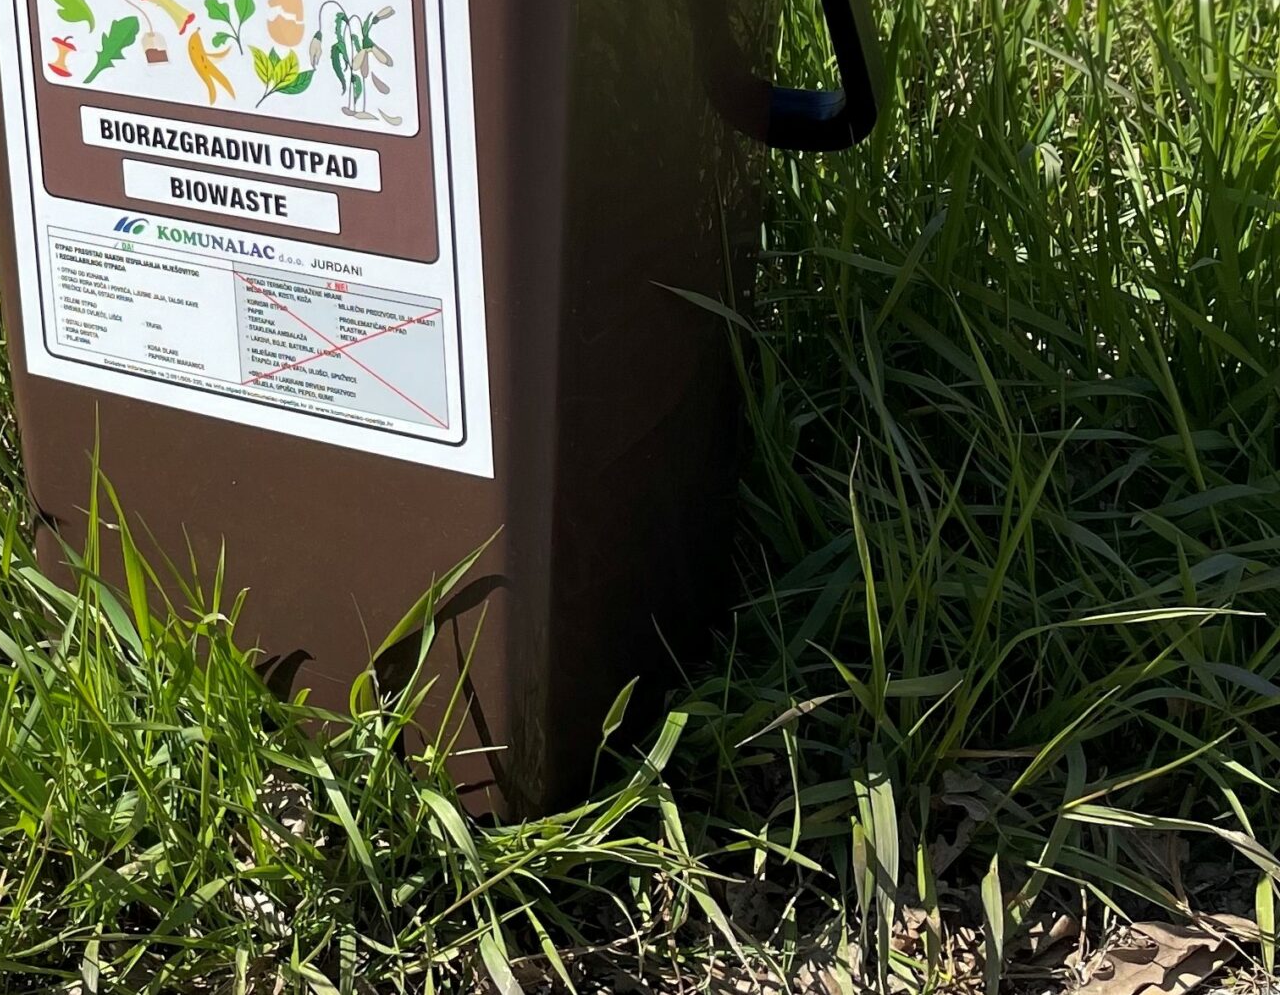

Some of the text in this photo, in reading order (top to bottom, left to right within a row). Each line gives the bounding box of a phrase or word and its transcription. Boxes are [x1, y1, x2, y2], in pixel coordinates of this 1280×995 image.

[99, 117, 359, 180] BIORAZGRADIVI OTPAD
[170, 175, 289, 217] BIOWASTE
[157, 225, 364, 277] KOMUNALAC d.o.o. JURDANI
